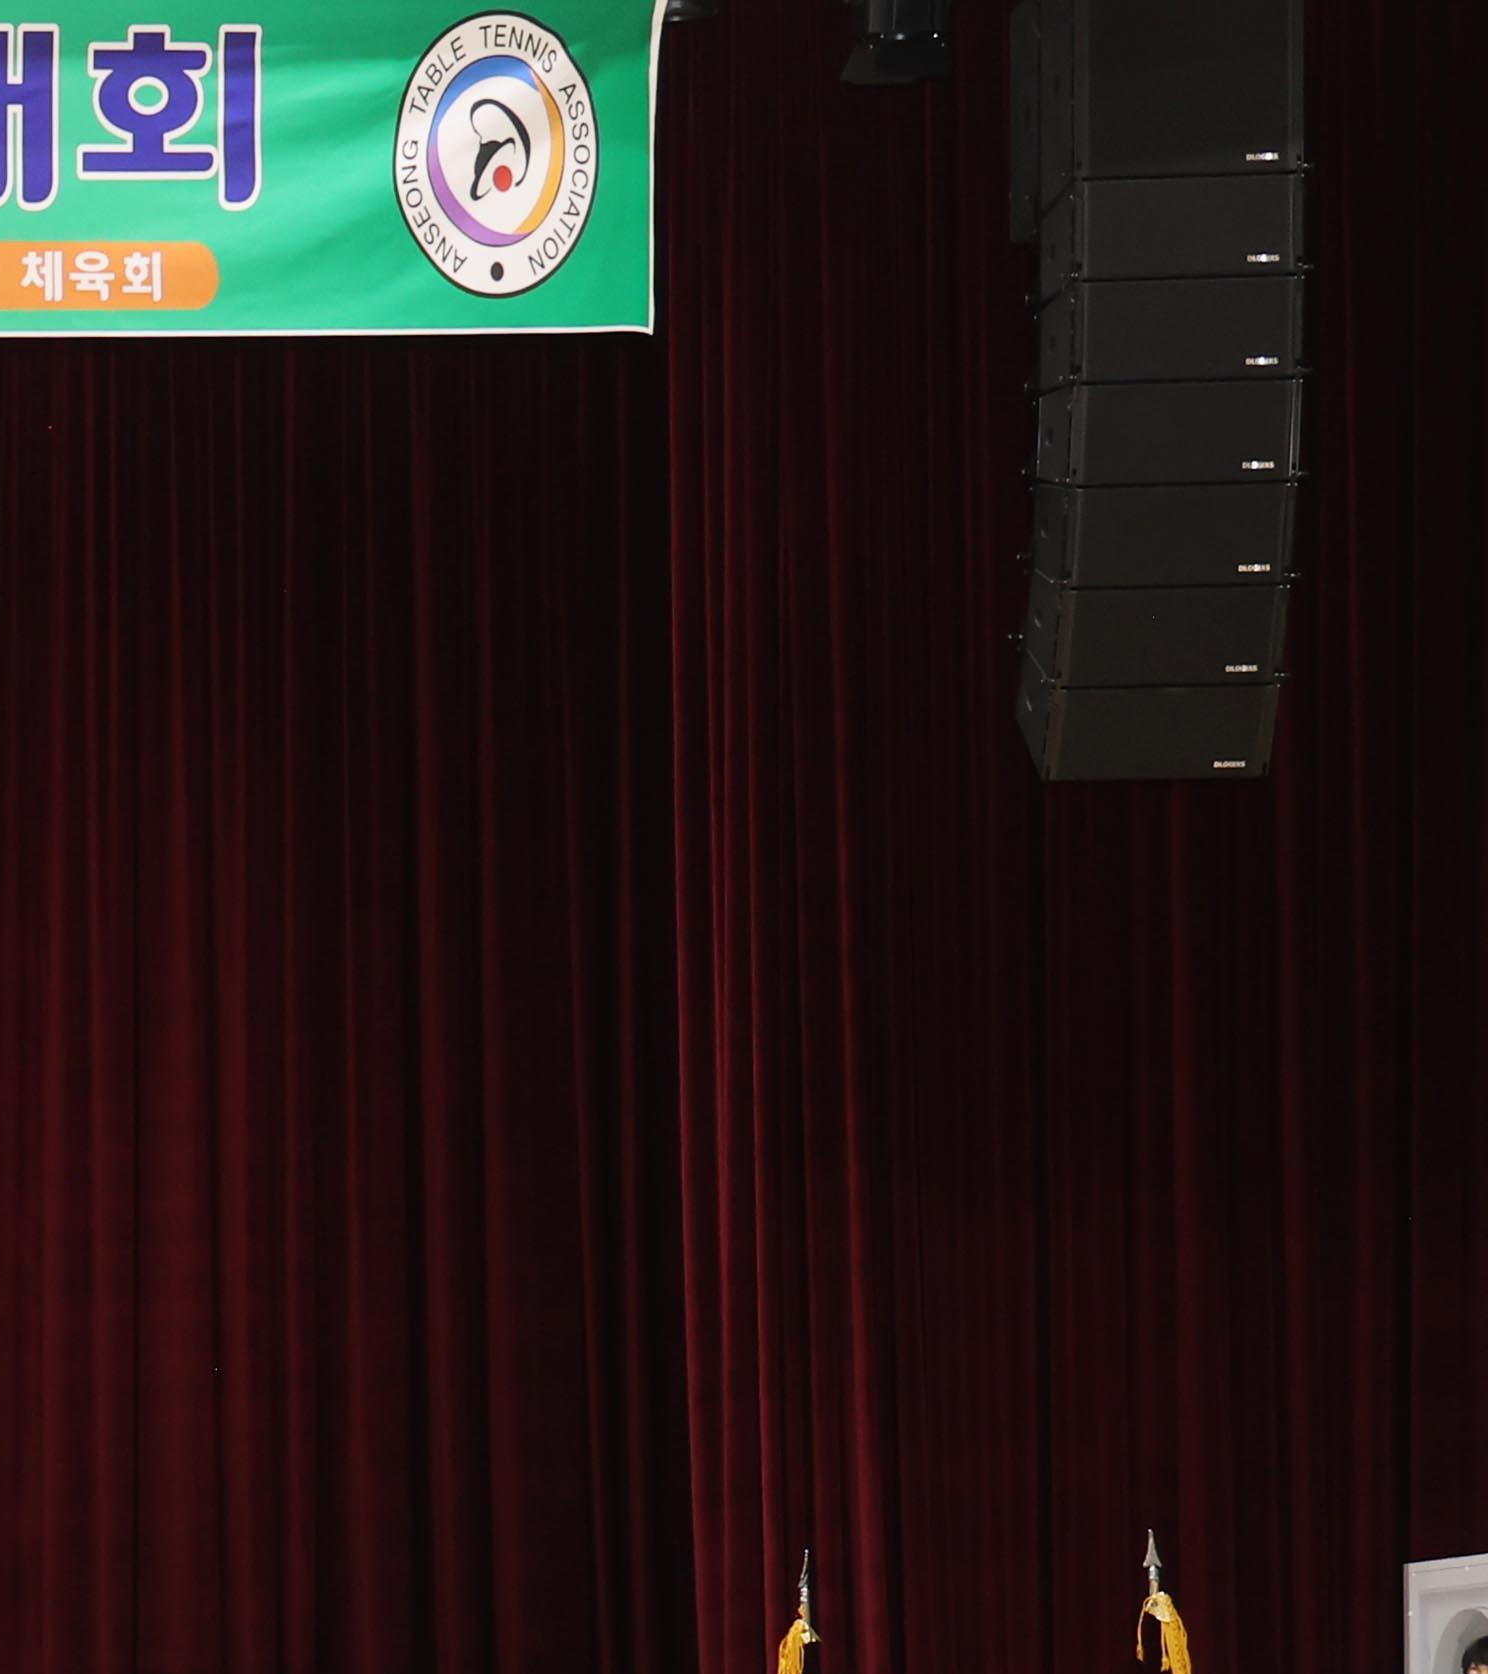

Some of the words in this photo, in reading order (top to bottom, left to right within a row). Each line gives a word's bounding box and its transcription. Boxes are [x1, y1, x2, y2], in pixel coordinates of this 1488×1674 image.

[408, 35, 467, 114] TABLE
[479, 24, 558, 74] TENNIS
[401, 139, 468, 273] ANSEONG
[528, 82, 591, 276] ASSOCIATION
[20, 250, 165, 304] 체육회
